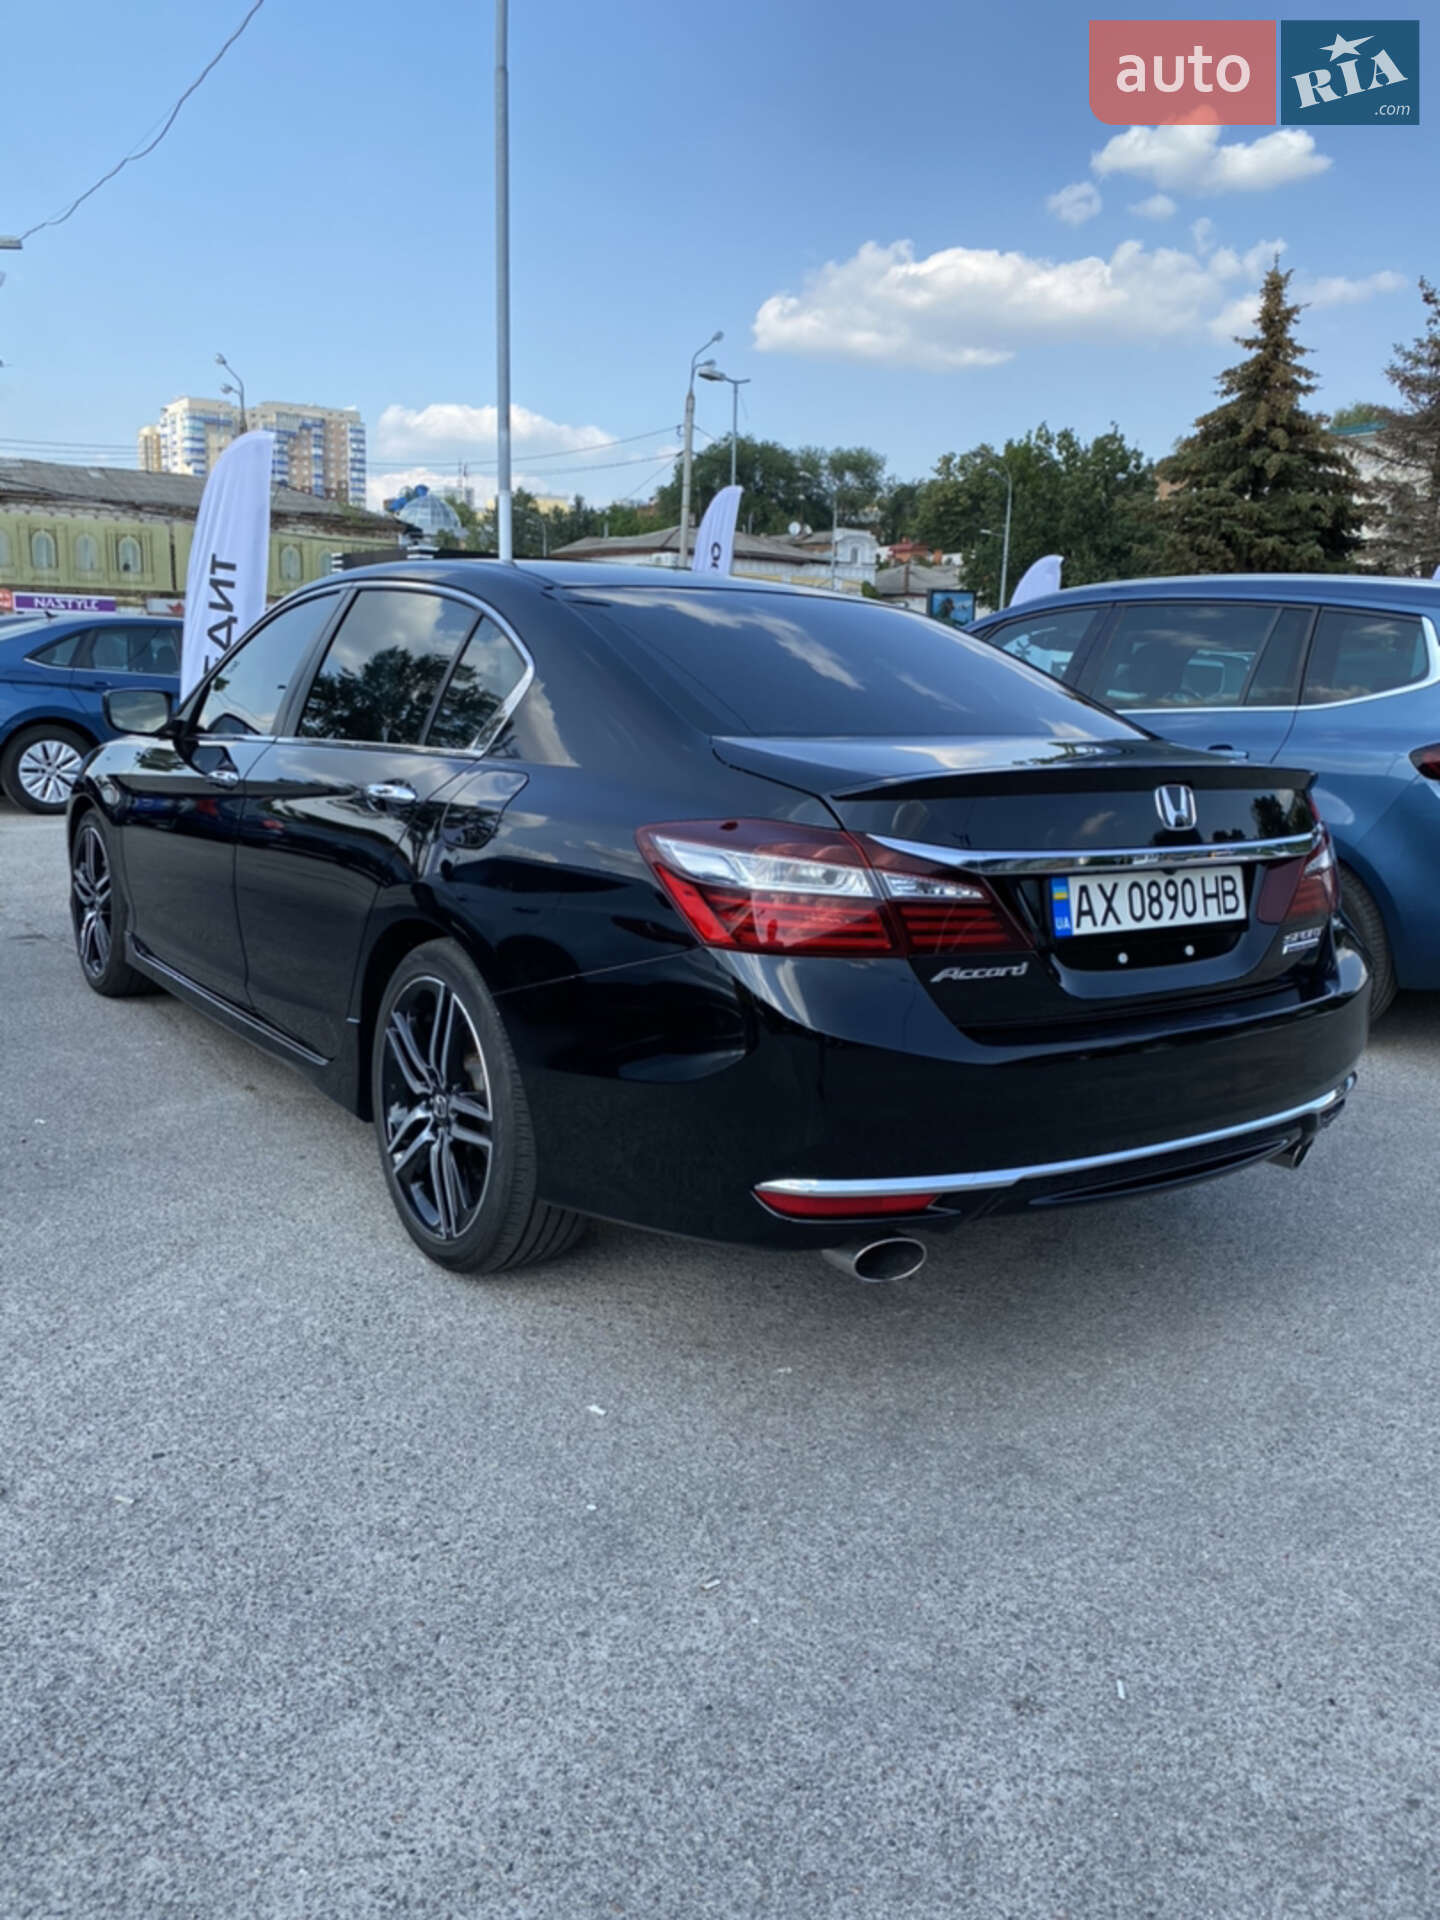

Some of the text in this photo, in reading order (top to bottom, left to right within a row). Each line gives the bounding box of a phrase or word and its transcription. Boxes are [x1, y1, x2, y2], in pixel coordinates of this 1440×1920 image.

[1076, 874, 1240, 929] AX 0890 HB
[1055, 916, 1071, 930] UA
[930, 961, 1029, 983] Accord
